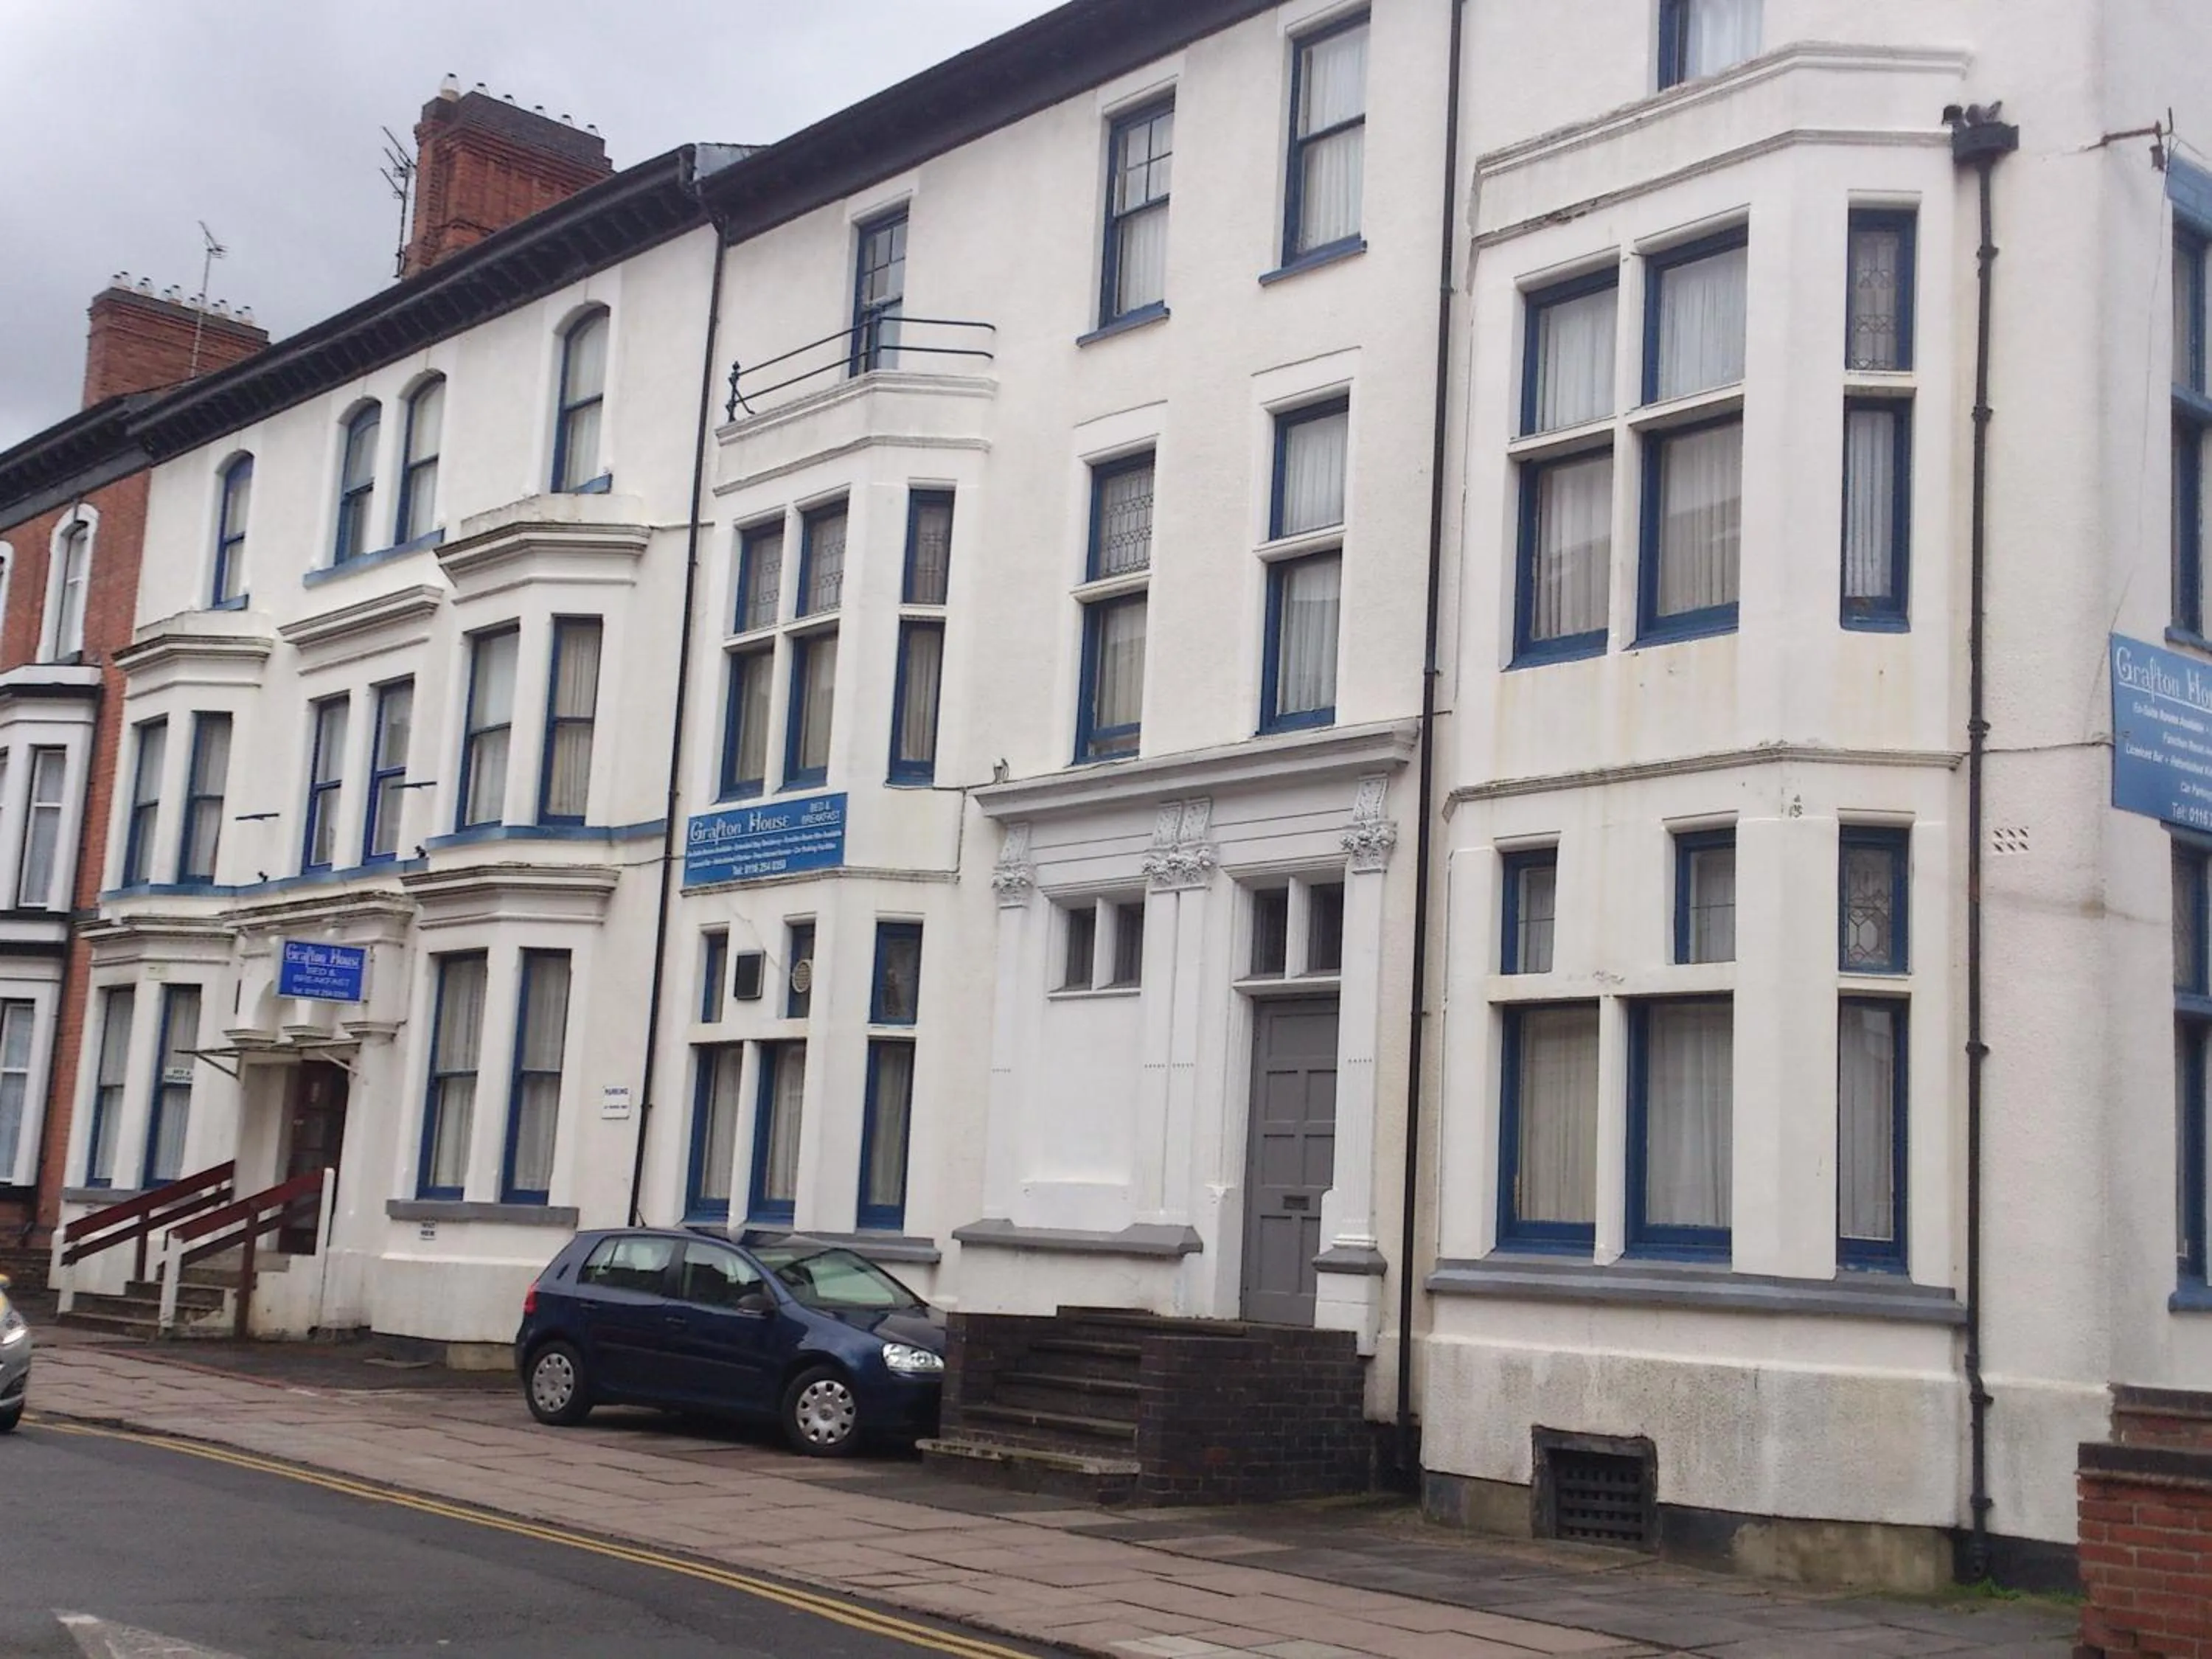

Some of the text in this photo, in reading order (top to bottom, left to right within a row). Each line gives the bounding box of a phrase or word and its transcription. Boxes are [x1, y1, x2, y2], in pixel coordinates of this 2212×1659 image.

[2116, 646, 2180, 704] Grafton
[690, 818, 742, 845] Grafton
[748, 811, 790, 832] House
[285, 943, 326, 968] Grafton
